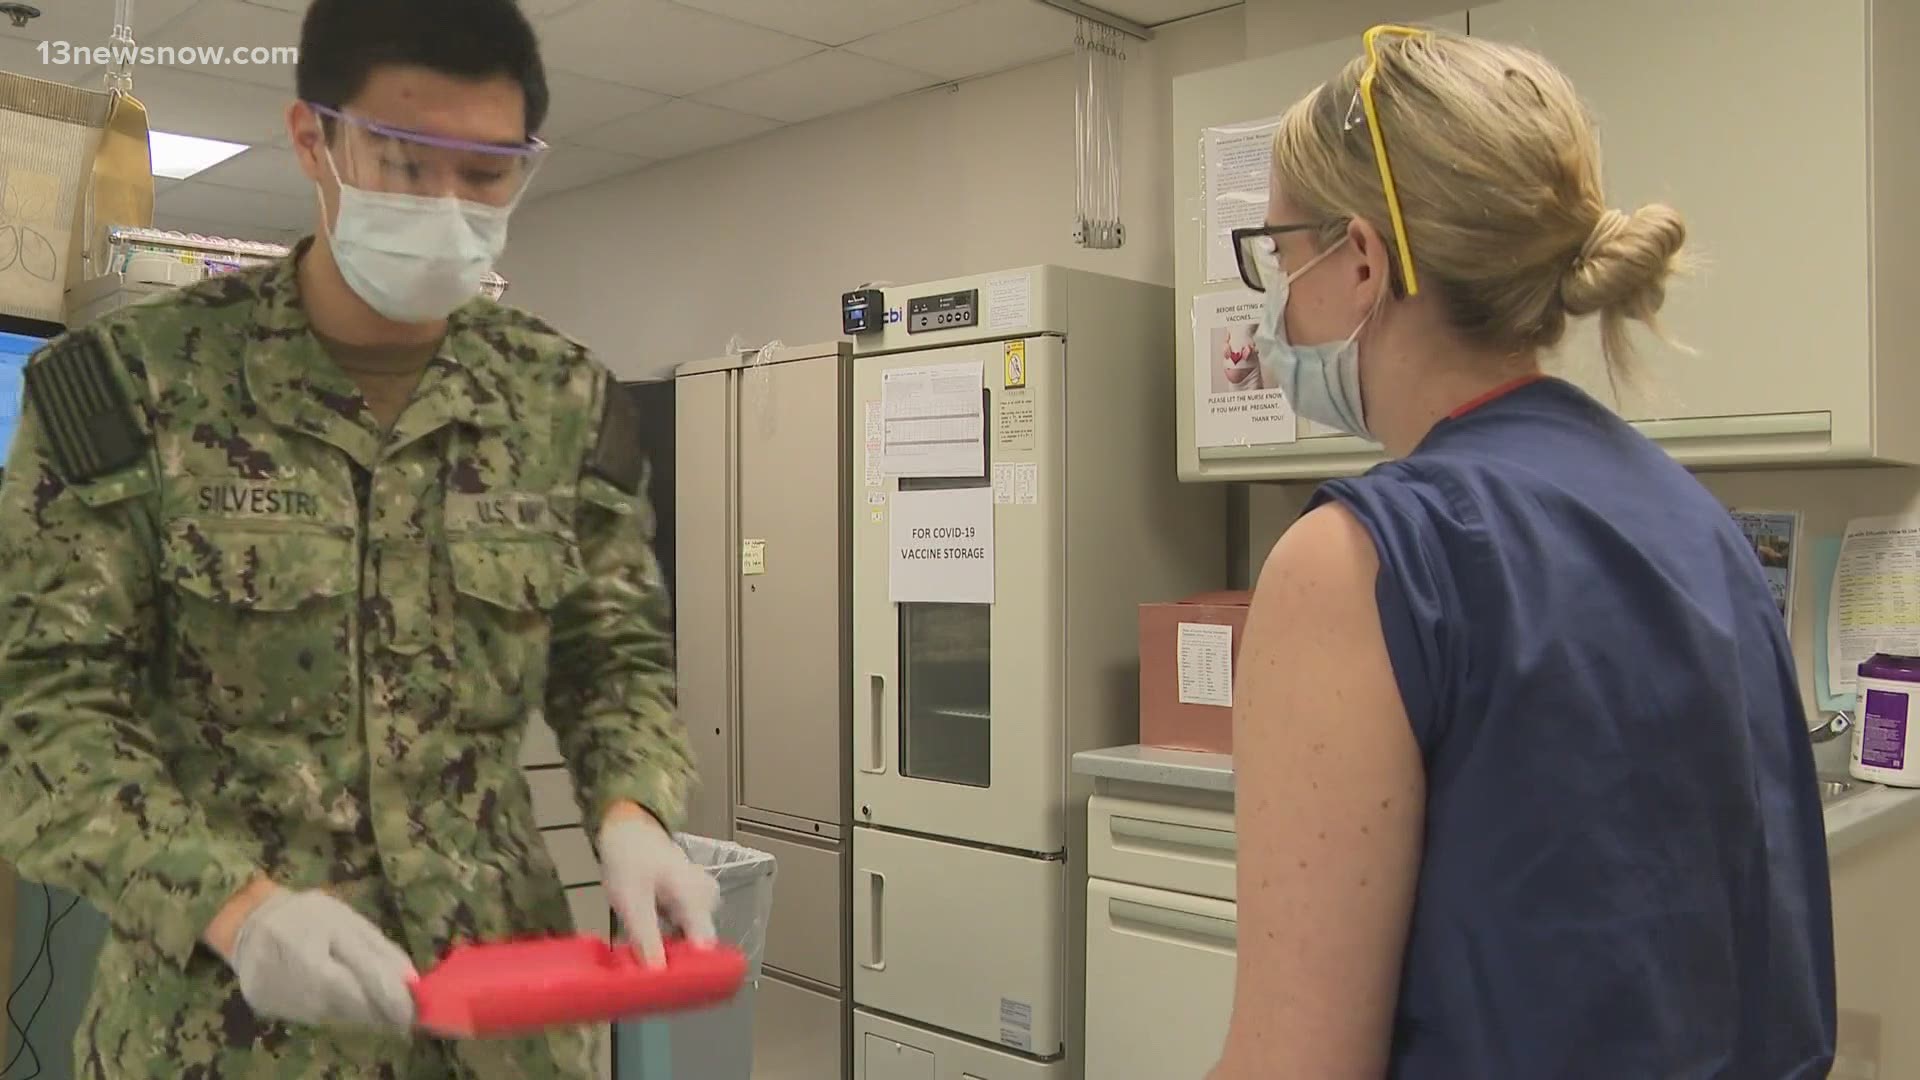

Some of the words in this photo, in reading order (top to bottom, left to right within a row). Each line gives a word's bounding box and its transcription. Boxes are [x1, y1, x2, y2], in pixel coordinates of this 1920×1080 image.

[1216, 305, 1235, 314] BEFORE
[1236, 303, 1259, 312] GETTING
[1208, 396, 1226, 404] PLEASE
[1226, 395, 1236, 403] LET
[1251, 415, 1269, 423] THANK
[912, 528, 931, 539] FOR
[933, 527, 976, 539] COVID-19
[900, 549, 942, 560] VACCINE
[943, 548, 985, 559] STORAGE
